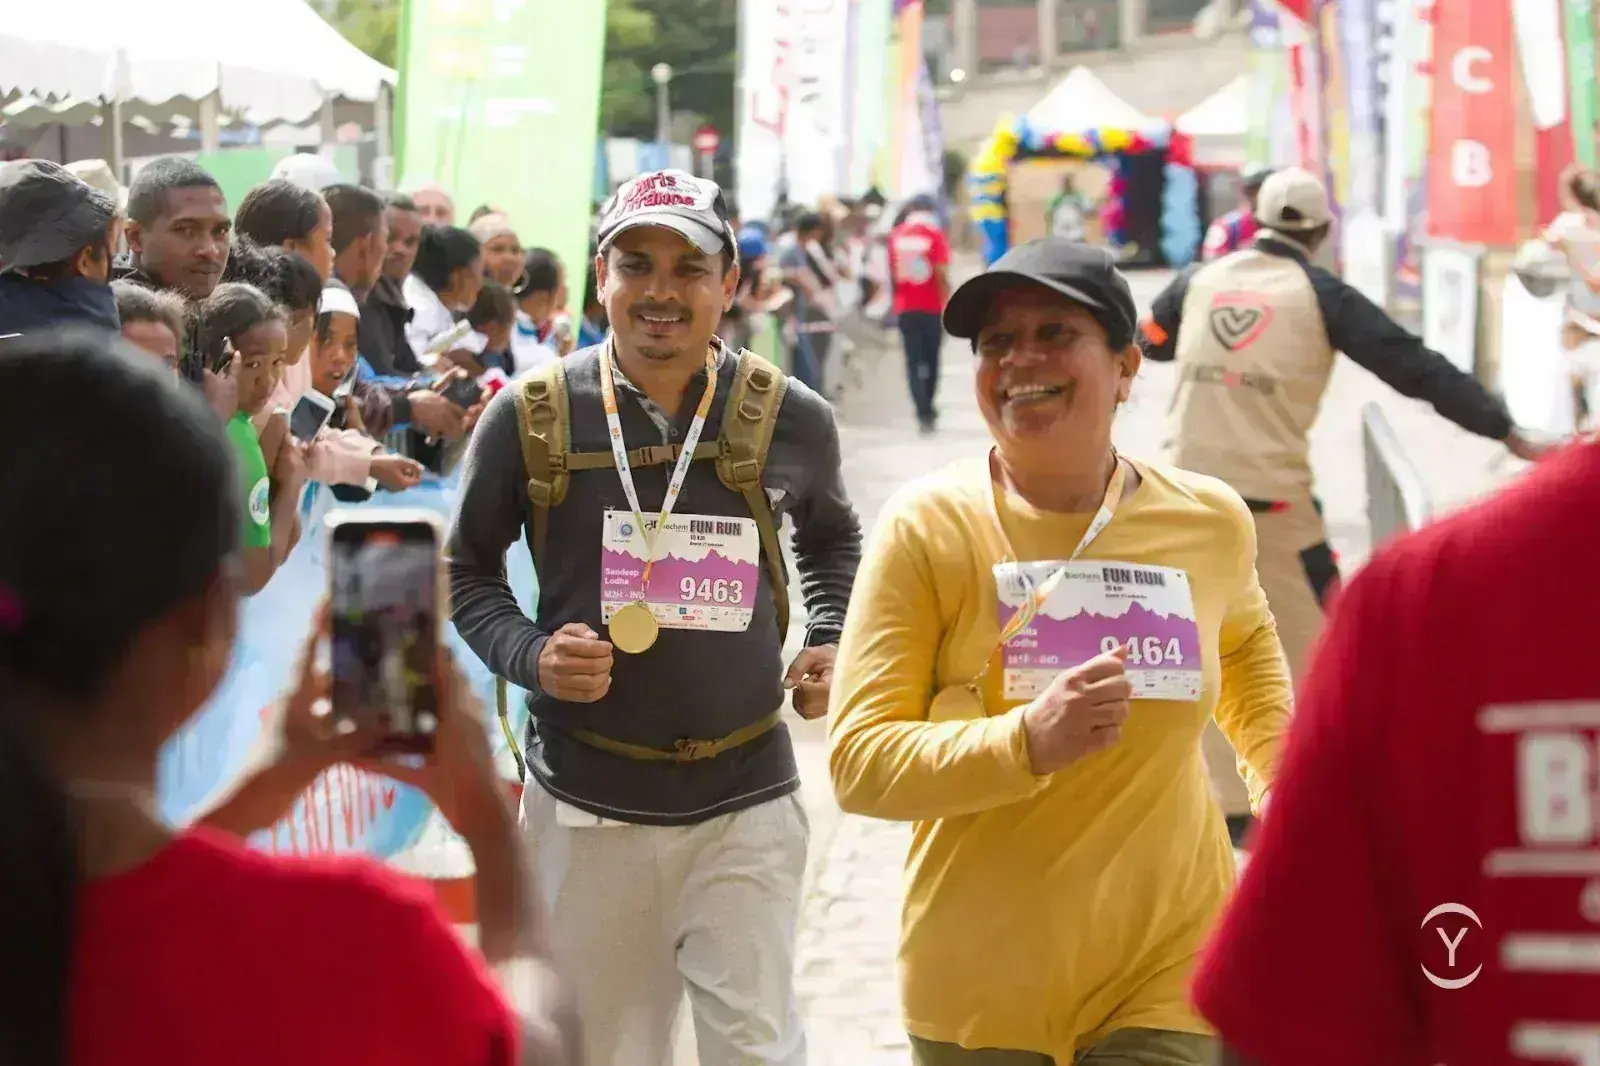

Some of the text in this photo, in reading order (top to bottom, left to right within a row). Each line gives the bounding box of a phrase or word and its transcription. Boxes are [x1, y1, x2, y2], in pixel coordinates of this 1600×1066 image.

[690, 520, 714, 534] FUN
[716, 521, 742, 536] RUN
[605, 568, 640, 577] Sandeep
[1103, 567, 1133, 584] FUN
[1134, 570, 1166, 587] RUN
[680, 576, 743, 604] 9463
